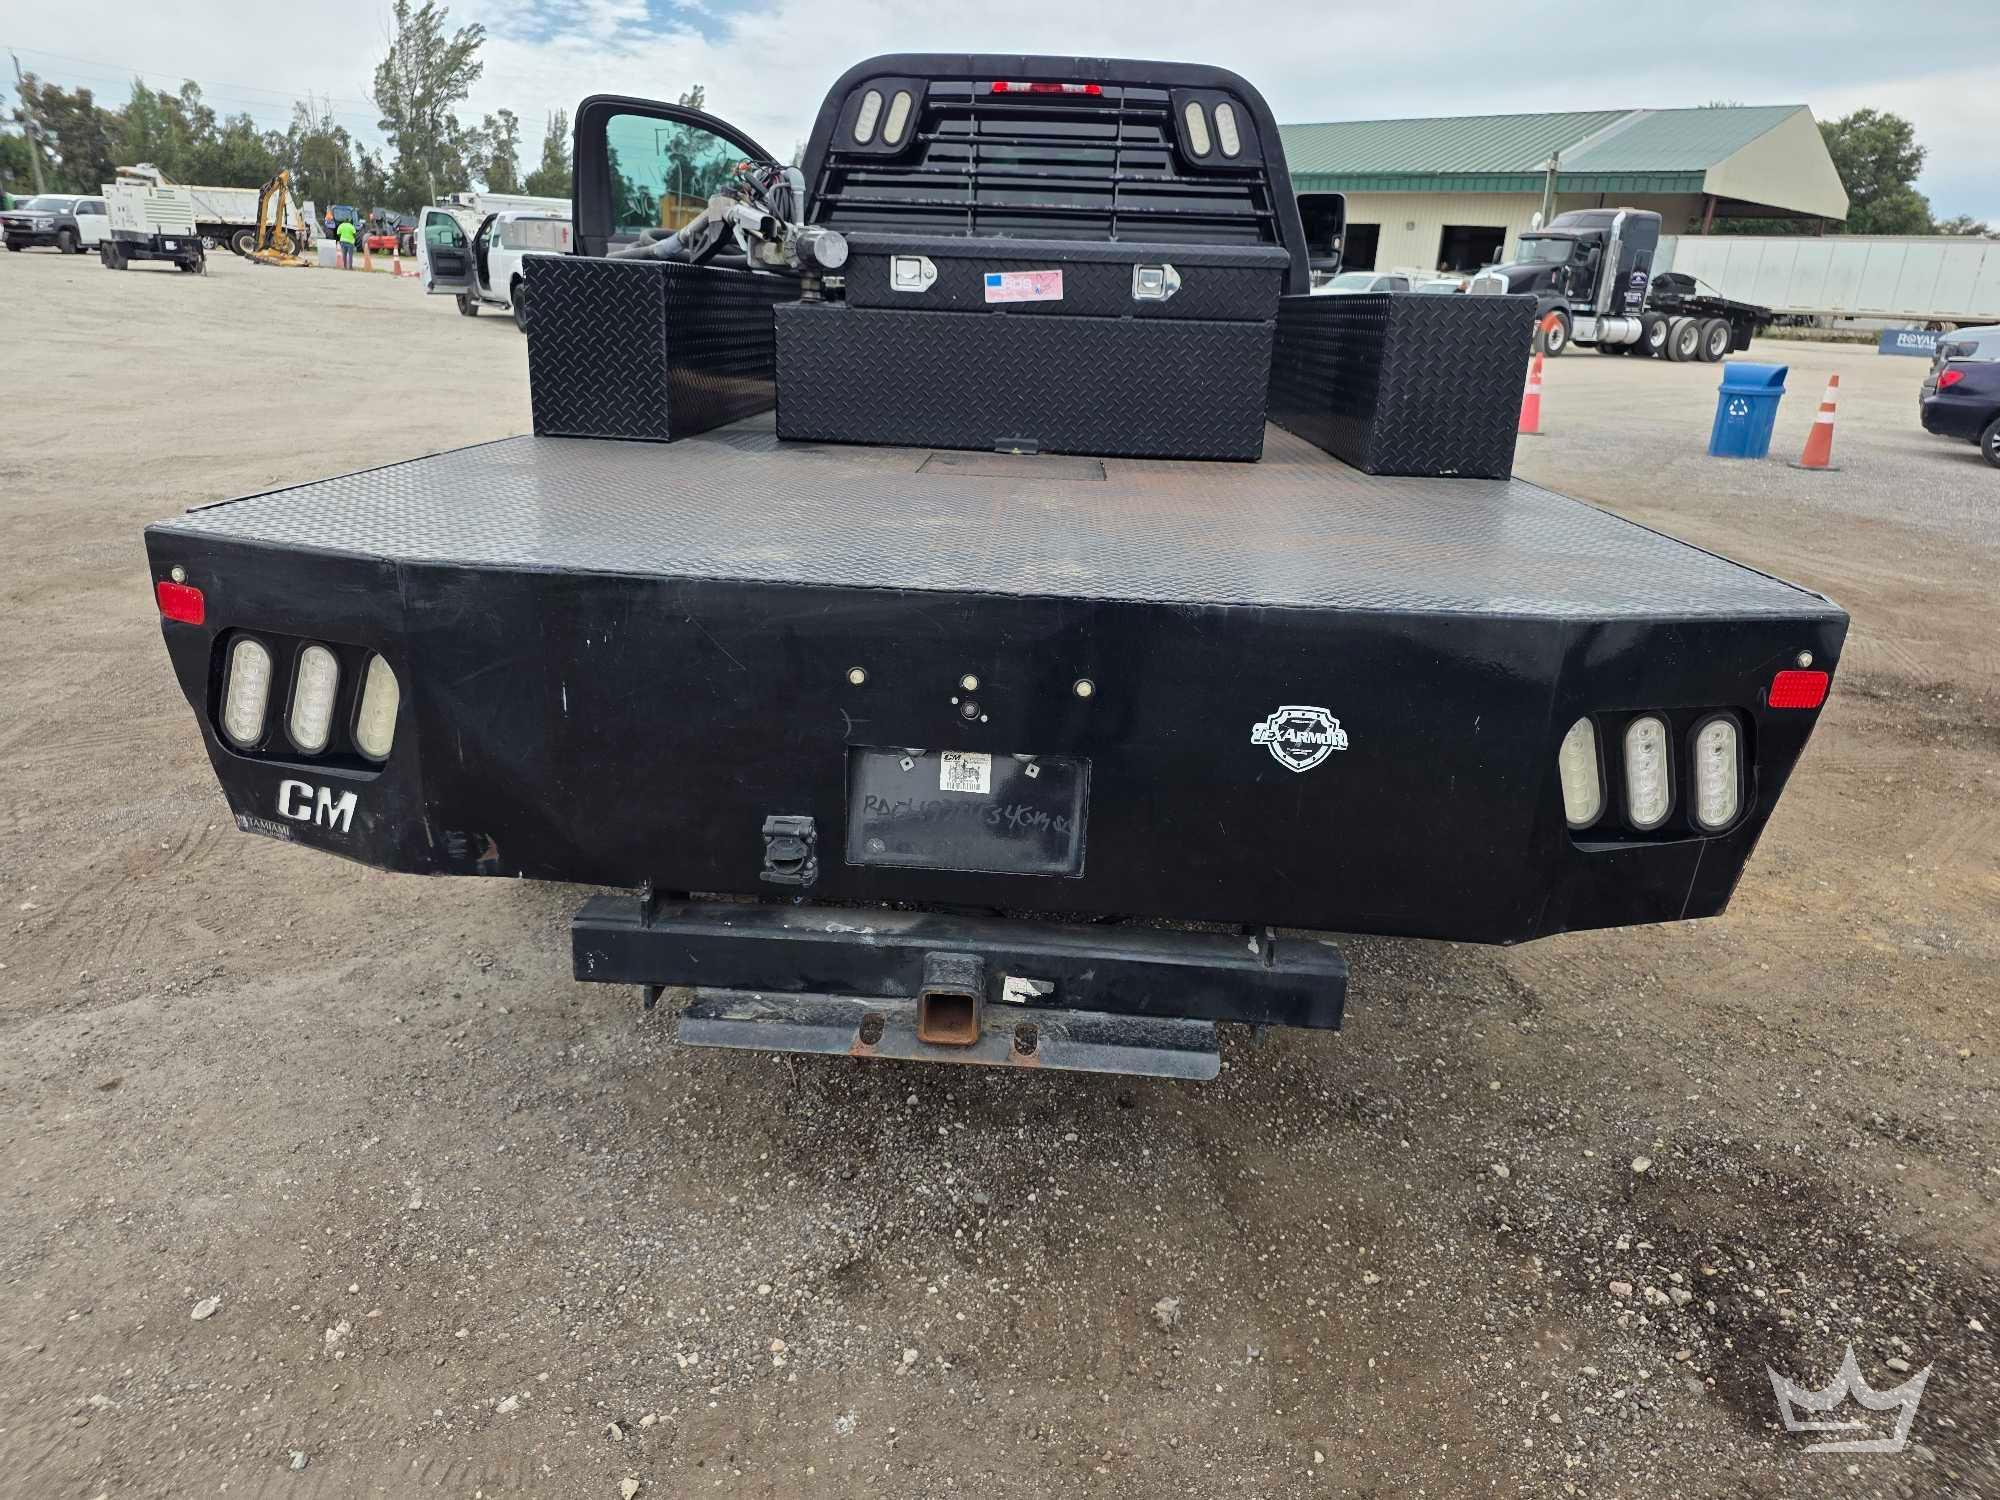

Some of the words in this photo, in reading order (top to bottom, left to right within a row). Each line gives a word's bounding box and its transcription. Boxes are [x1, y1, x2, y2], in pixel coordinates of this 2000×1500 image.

[1897, 333, 1936, 346] ROYAL
[278, 779, 358, 833] CM
[247, 816, 290, 835] TAMIAMI
